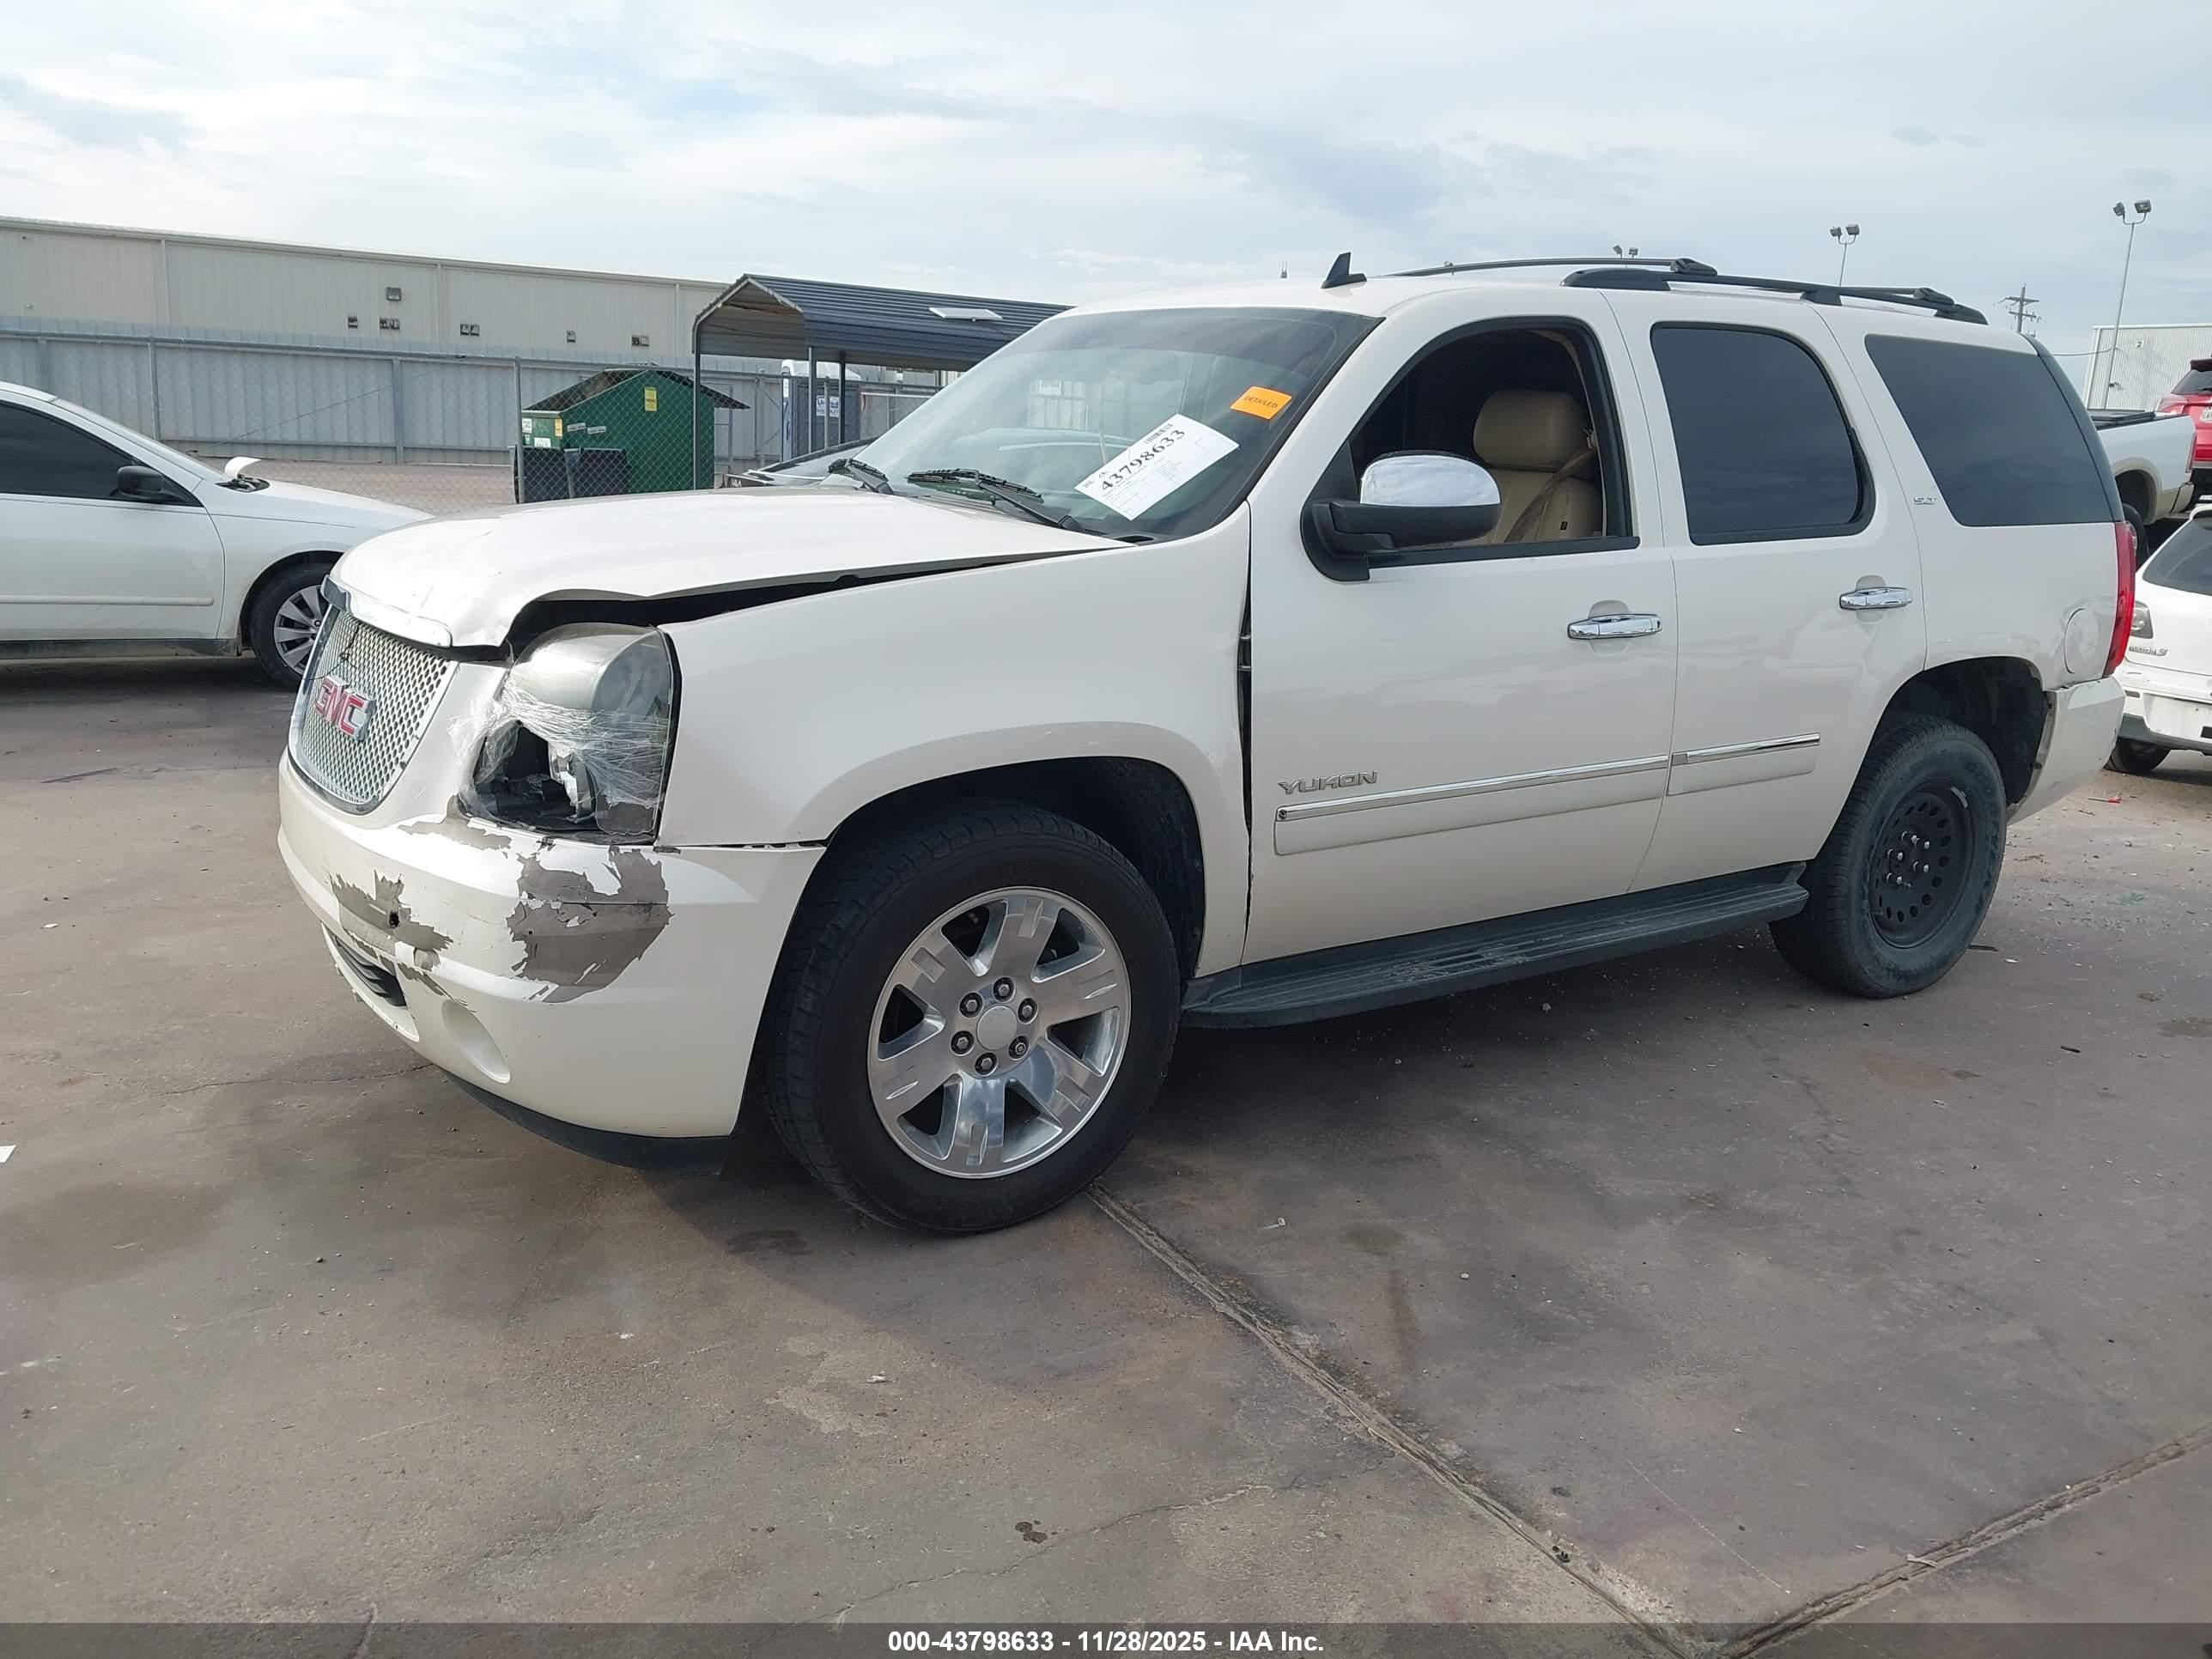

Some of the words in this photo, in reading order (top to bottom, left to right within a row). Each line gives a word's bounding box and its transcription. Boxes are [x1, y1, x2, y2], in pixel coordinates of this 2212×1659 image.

[1243, 395, 1279, 409] DETAILED
[1101, 429, 1186, 490] 43798633
[313, 676, 375, 740] GMC
[1277, 770, 1378, 795] YUKON
